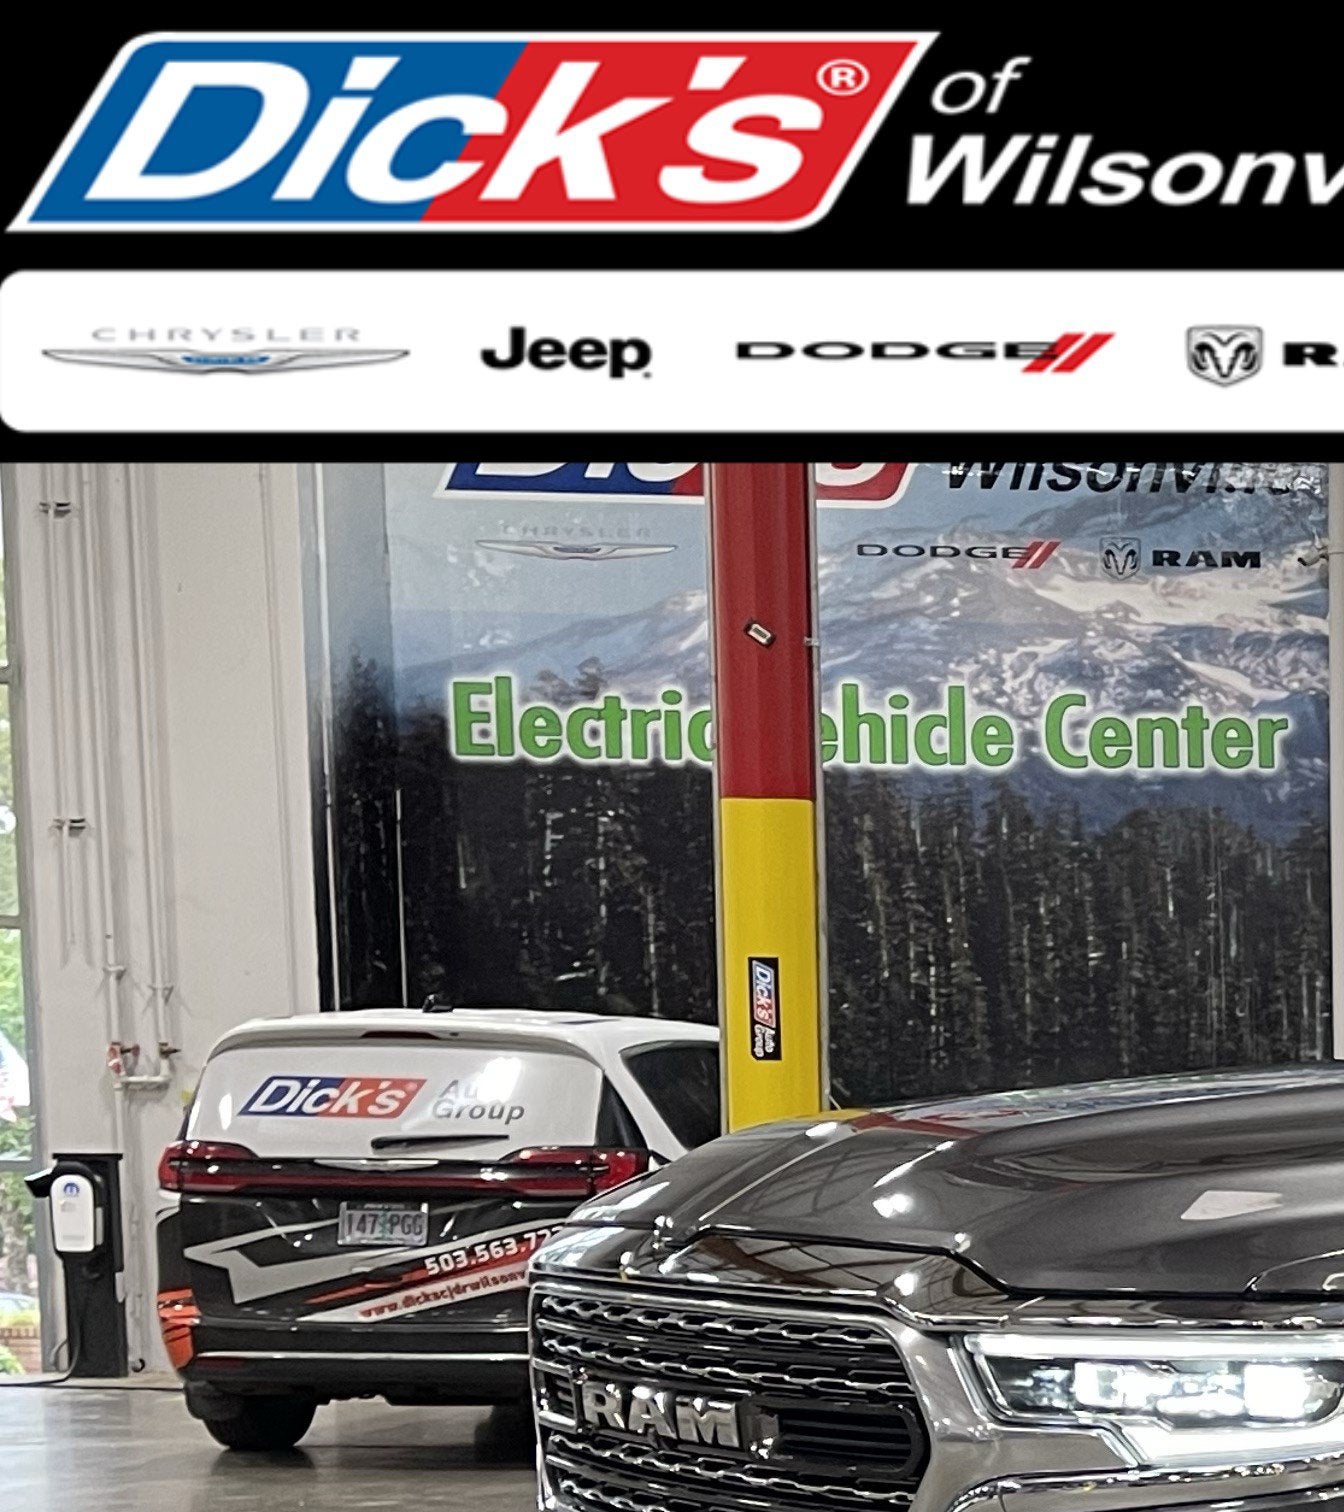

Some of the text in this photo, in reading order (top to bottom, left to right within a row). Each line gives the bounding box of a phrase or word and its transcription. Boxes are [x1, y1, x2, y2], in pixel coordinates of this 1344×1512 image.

[856, 542, 1030, 560] DODGE
[1151, 549, 1262, 569] RAM
[820, 682, 1015, 766] hicle
[1044, 692, 1290, 770] Center
[249, 1078, 407, 1116] Dick's
[432, 1099, 526, 1126] Group
[582, 1381, 740, 1449] RAM
